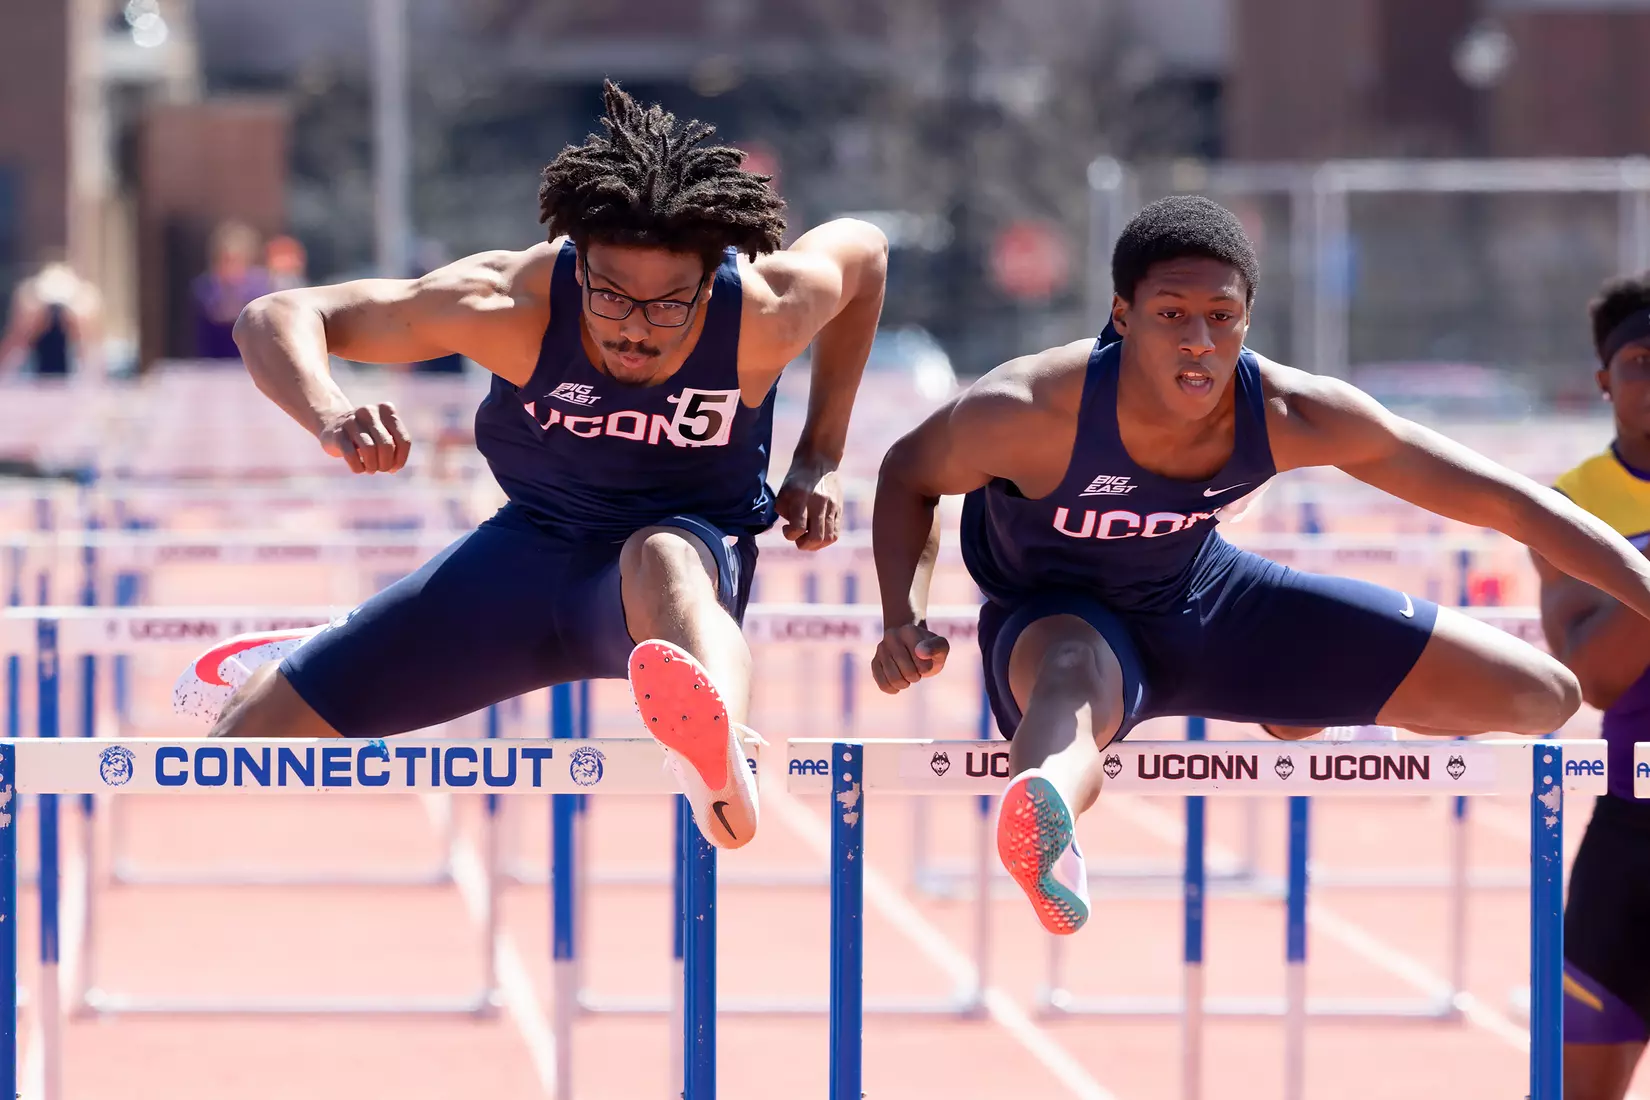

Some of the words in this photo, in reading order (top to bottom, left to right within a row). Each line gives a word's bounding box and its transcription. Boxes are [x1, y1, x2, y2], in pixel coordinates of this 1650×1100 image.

[548, 390, 602, 405] EAST
[558, 382, 594, 395] BIG
[523, 401, 702, 447] UCON
[678, 393, 728, 442] 5
[1083, 485, 1138, 494] EAST
[1091, 474, 1132, 485] BIG
[155, 745, 554, 788] CONNECTICUT
[1137, 754, 1258, 780] UCONN
[1309, 755, 1430, 781] UCONN
